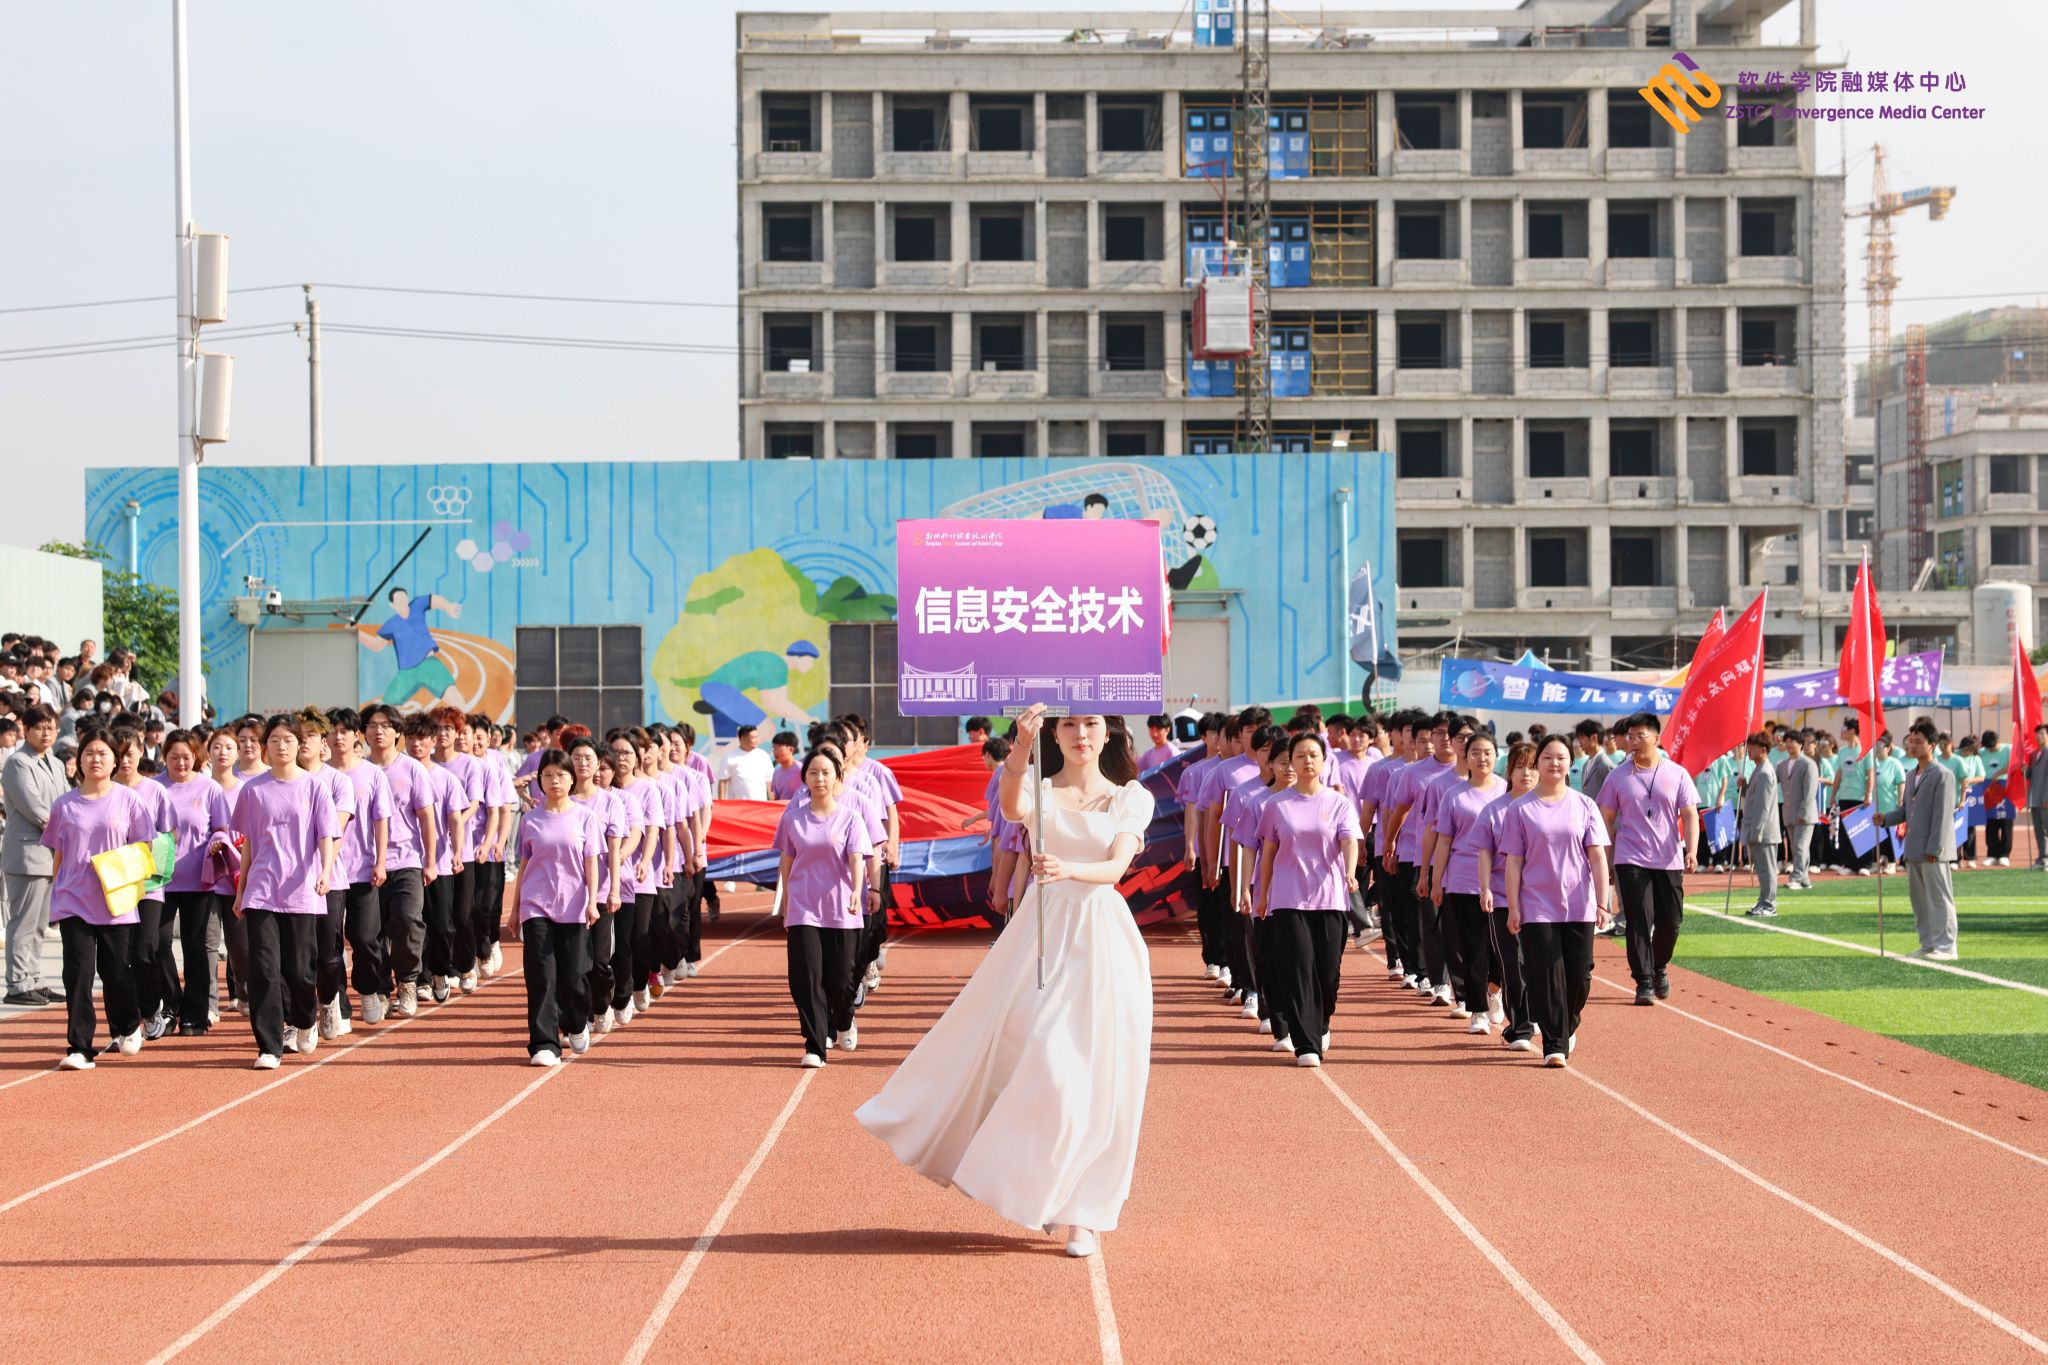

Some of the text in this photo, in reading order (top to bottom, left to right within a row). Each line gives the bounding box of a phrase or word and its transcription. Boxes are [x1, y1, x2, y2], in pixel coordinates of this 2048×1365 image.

[914, 585, 1145, 635] 信息安全技术
